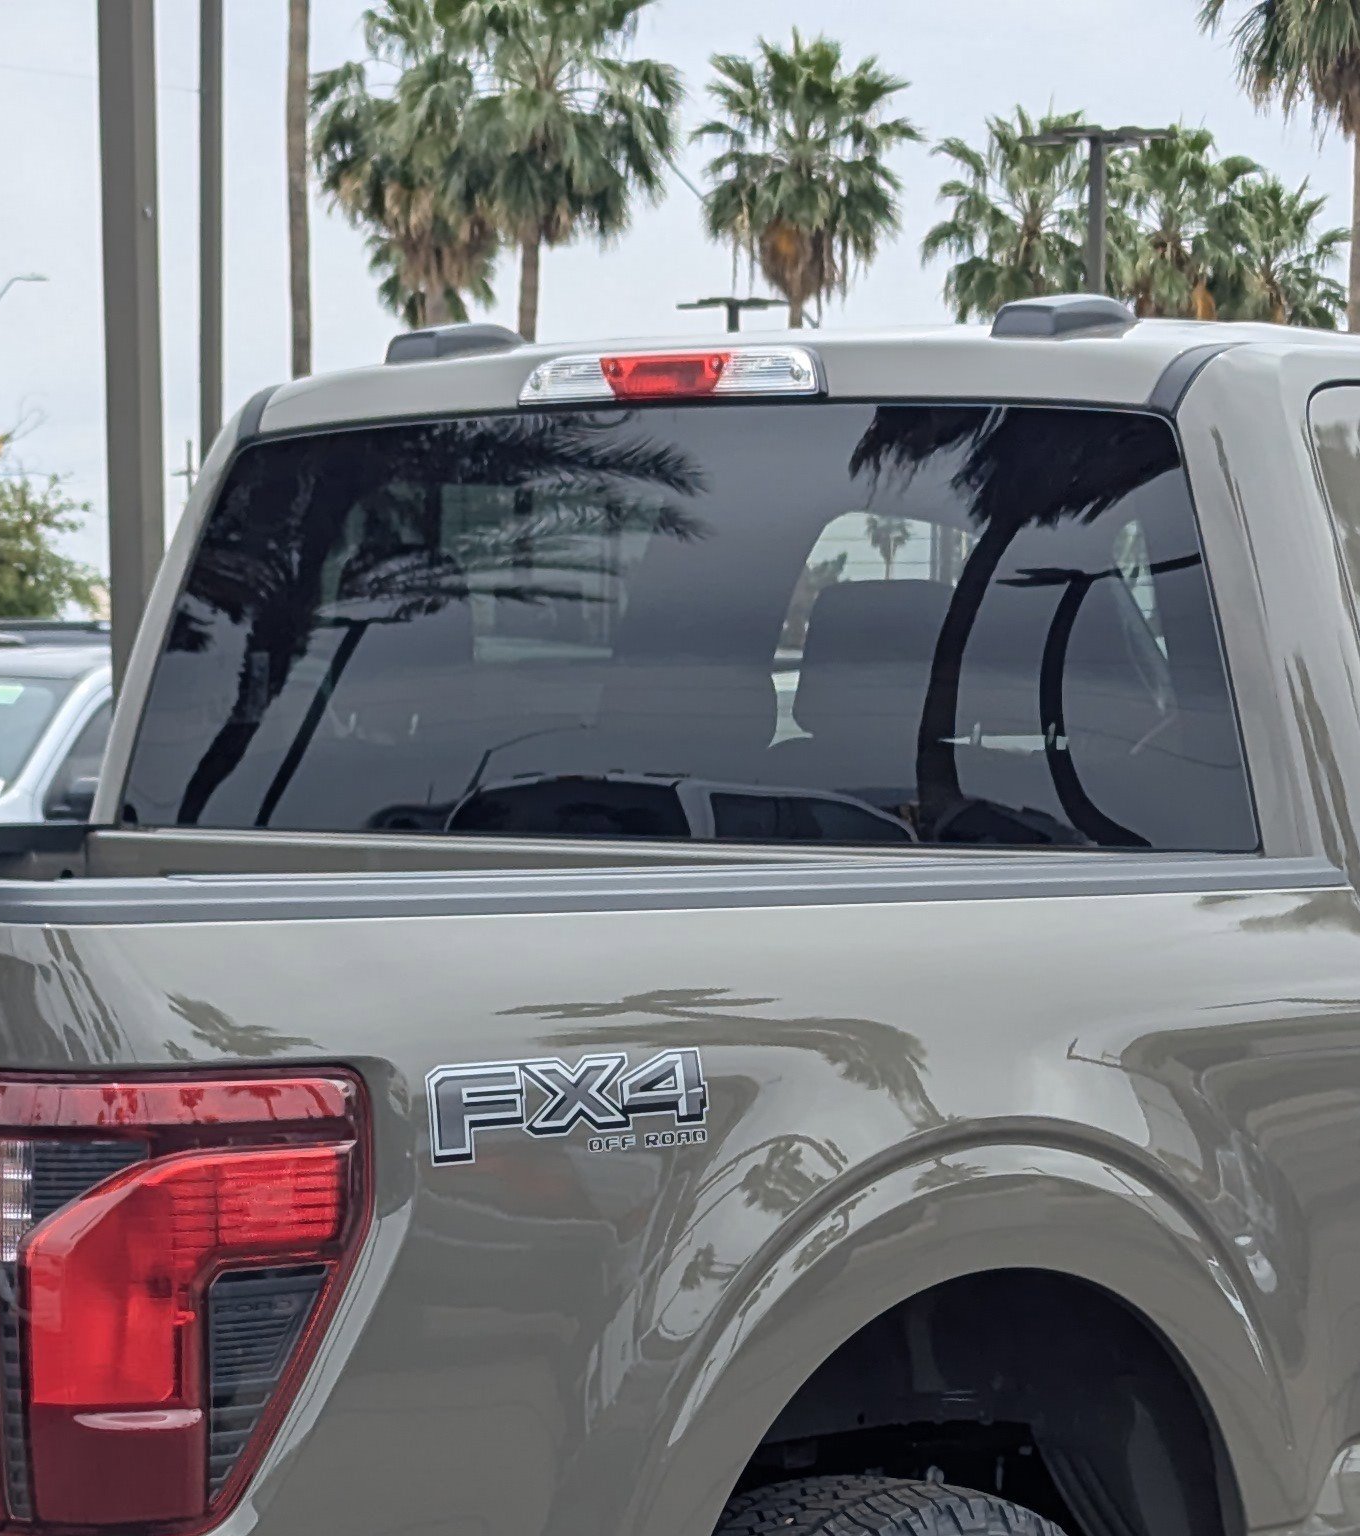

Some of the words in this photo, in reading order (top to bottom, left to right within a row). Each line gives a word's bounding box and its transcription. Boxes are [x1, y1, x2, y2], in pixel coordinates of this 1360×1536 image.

[425, 1047, 710, 1167] FX4
[588, 1133, 637, 1153] OFF
[644, 1129, 708, 1149] ROAD
